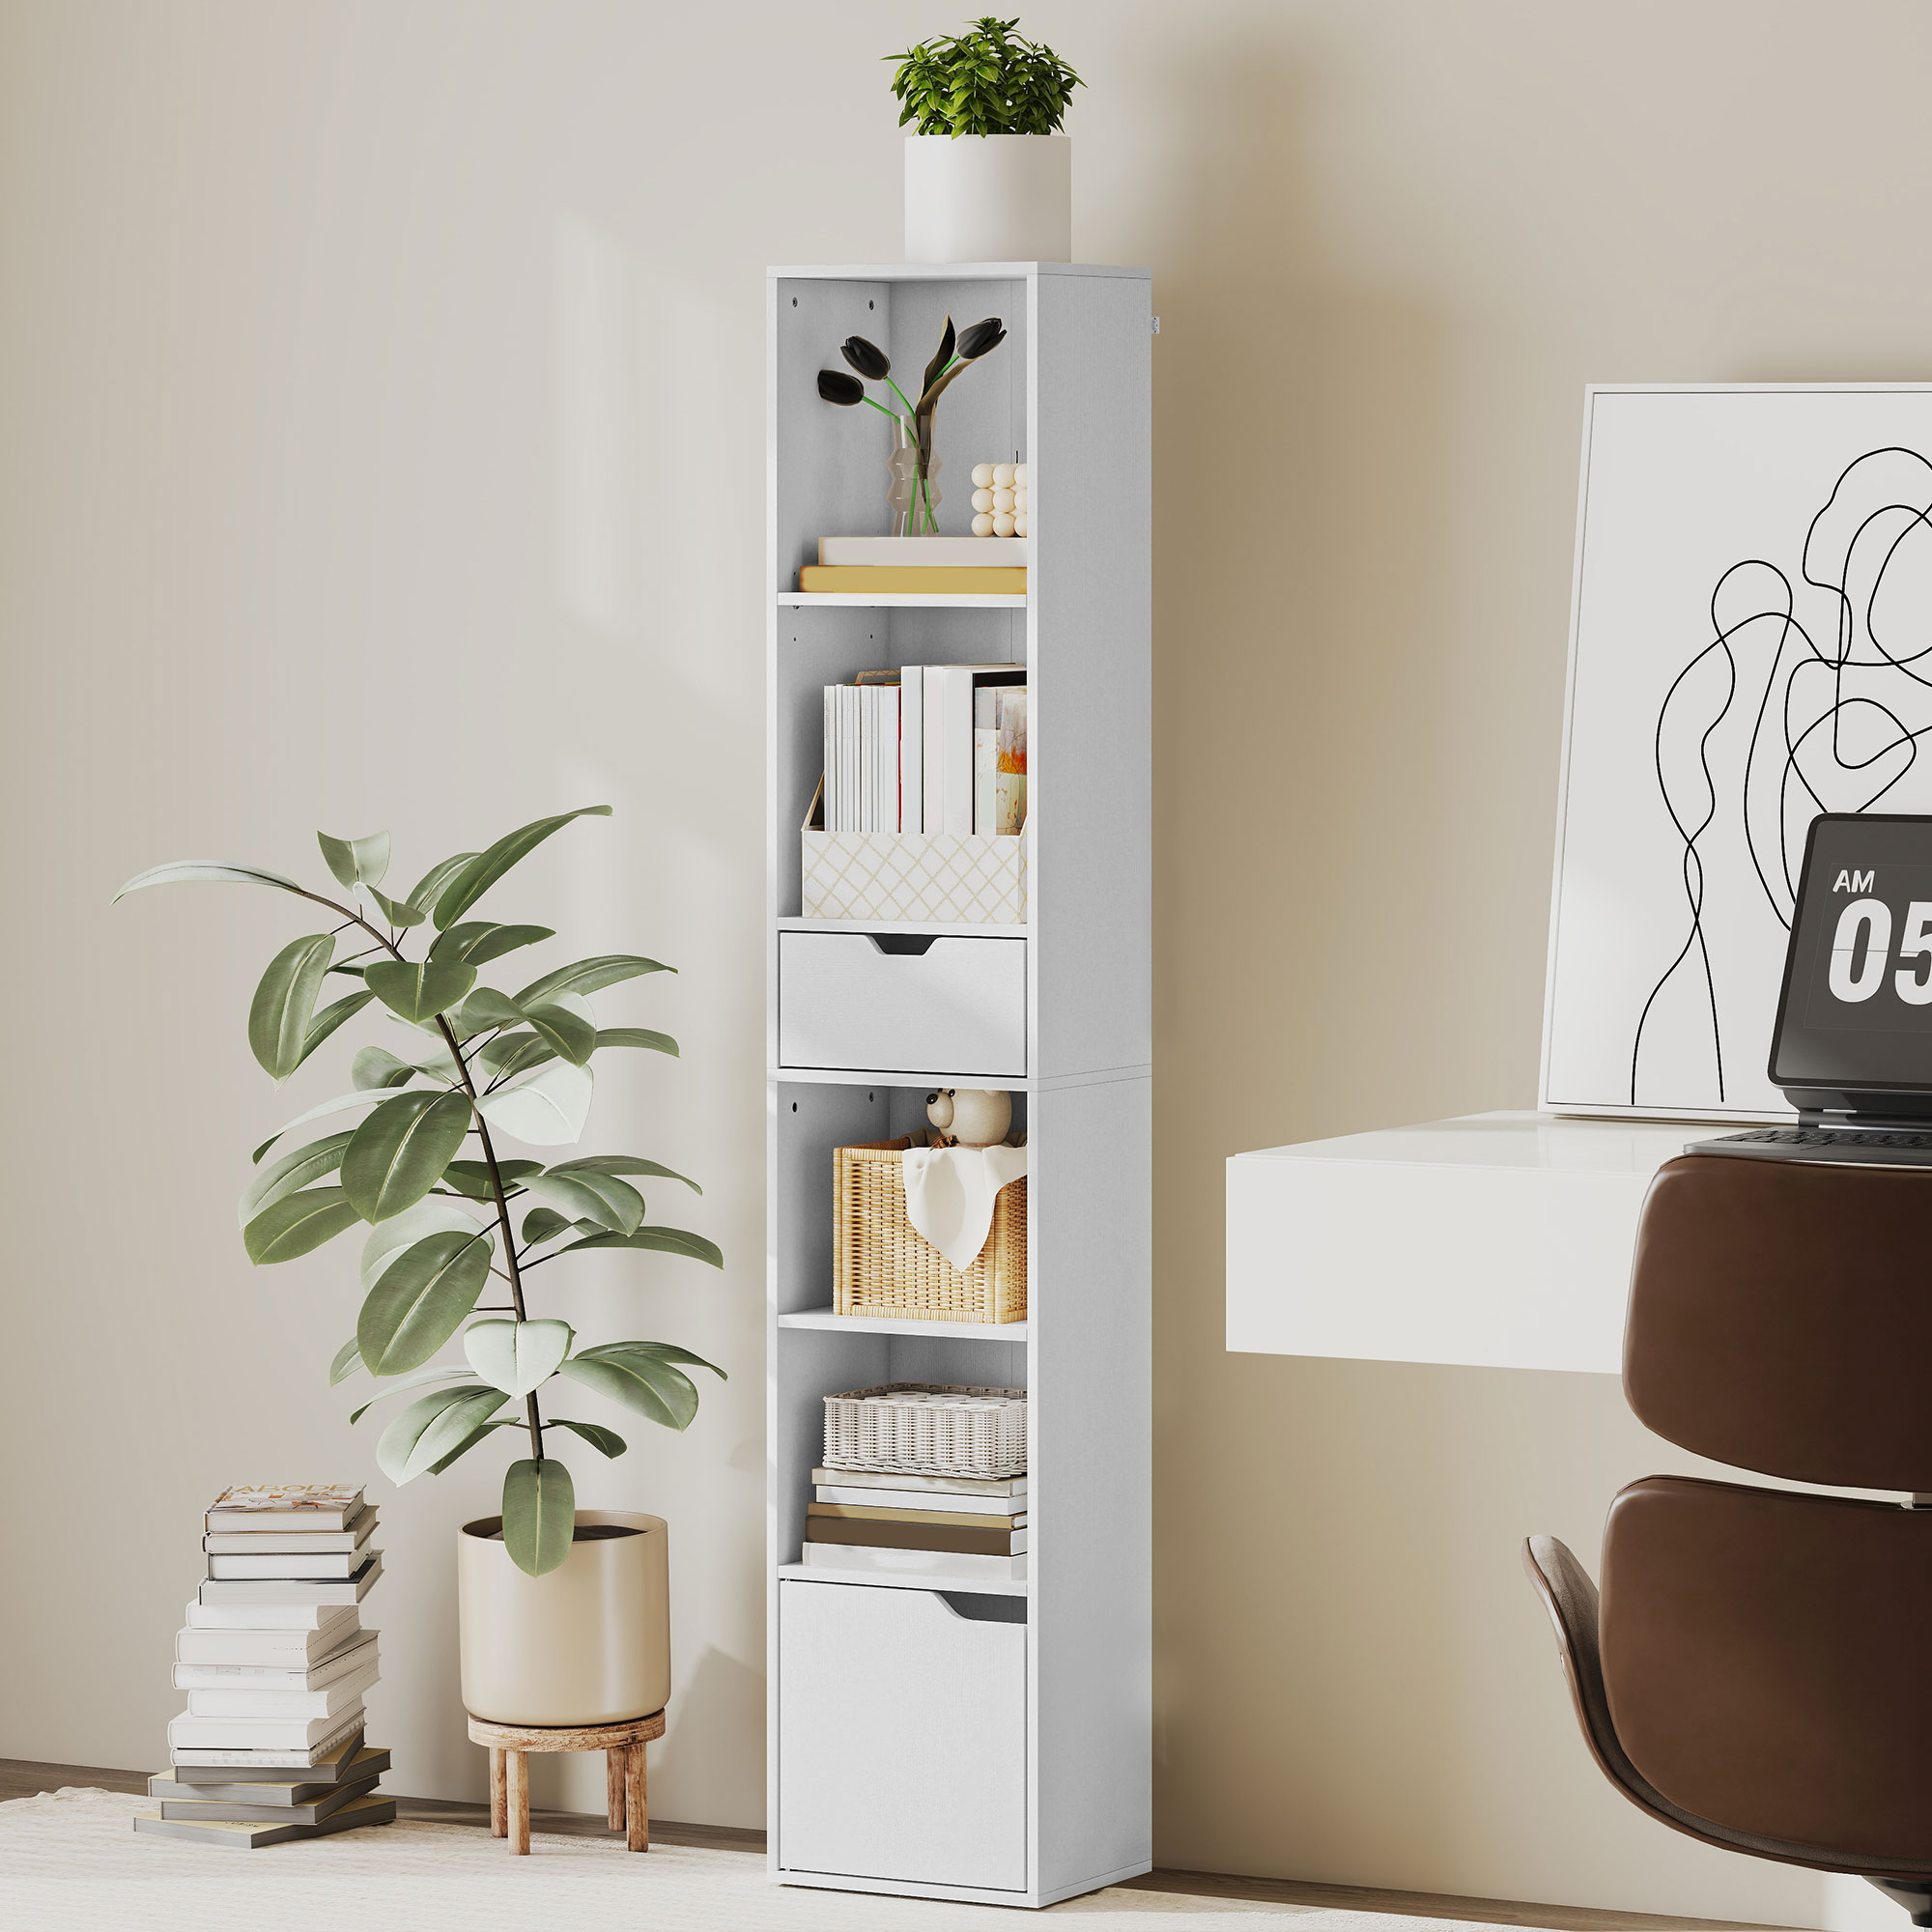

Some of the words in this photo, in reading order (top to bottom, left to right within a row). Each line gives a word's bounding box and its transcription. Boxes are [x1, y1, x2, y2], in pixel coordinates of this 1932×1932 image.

[1832, 869, 1875, 894] AM
[1829, 898, 1932, 1006] 05
[235, 1484, 354, 1492] ABODE
